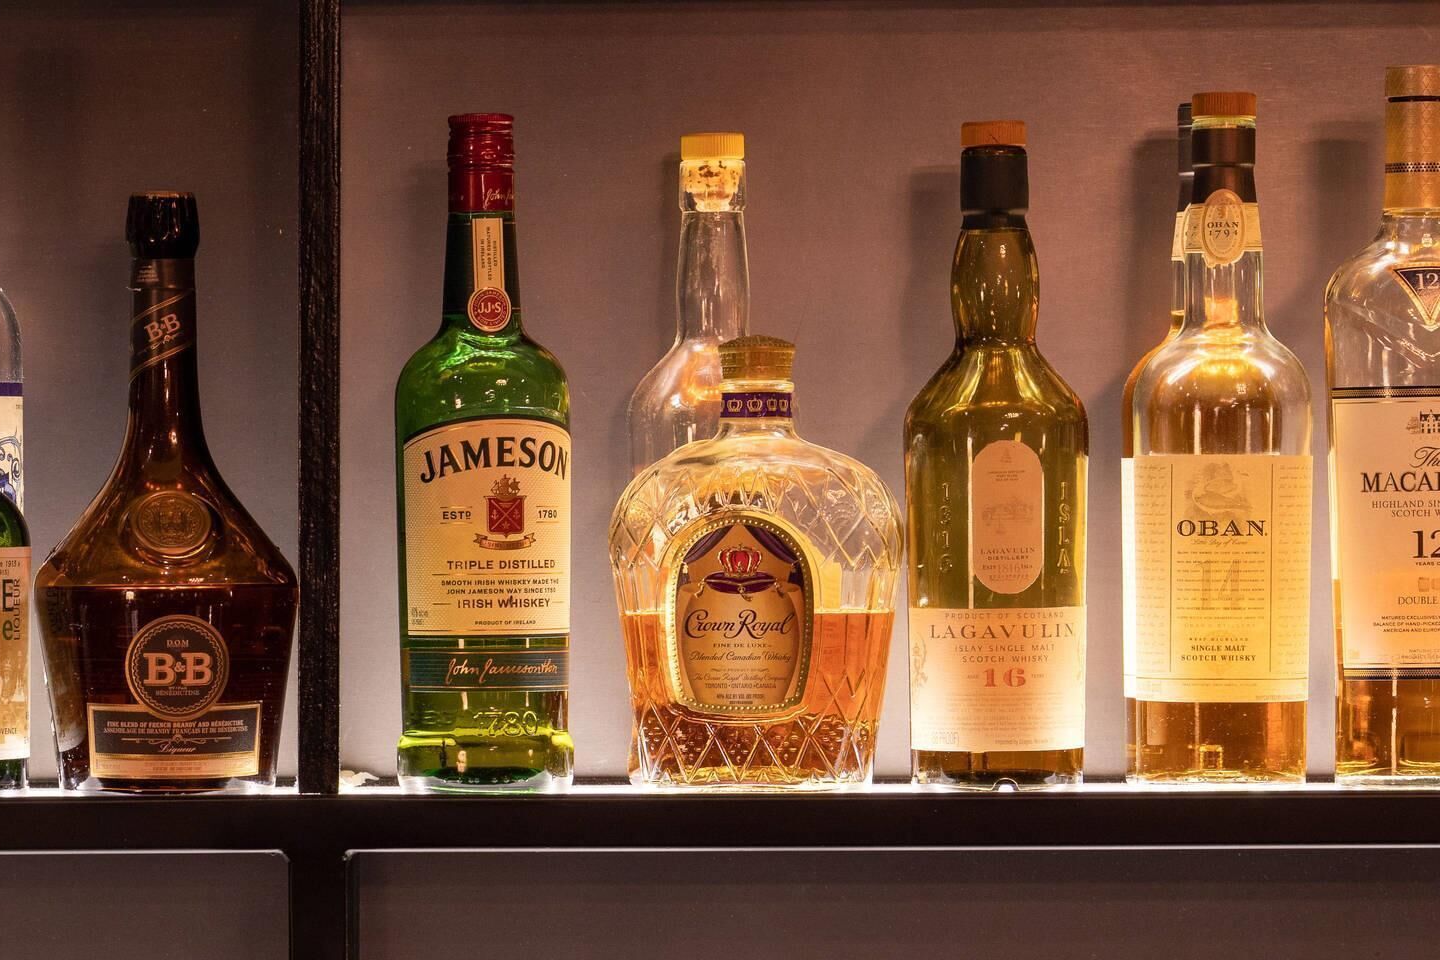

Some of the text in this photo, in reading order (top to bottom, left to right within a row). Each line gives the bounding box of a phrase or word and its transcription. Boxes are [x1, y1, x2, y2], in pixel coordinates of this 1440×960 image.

[1207, 221, 1239, 229] OBAN
[1208, 229, 1239, 238] 1794
[1416, 272, 1440, 291] 12
[145, 312, 182, 343] B&B
[420, 436, 569, 484] JAMESON
[1372, 499, 1425, 509] HIGHLAND
[537, 509, 558, 519] 1780
[1391, 508, 1431, 517] SCOTCH
[446, 559, 556, 570] TRIPLE DISTILLED
[457, 597, 551, 609] IRISH WHISKEY
[1397, 596, 1438, 606] DOUBLE
[13, 578, 21, 641] LIQUEUR
[945, 612, 993, 620] PRODUCT
[1016, 611, 1065, 619] SCOTLAND
[684, 608, 796, 640] Crown Royal
[930, 622, 1075, 640] LAGAVULIN
[955, 643, 1055, 653] ISLAY SINGLE MALT
[689, 650, 792, 664] Blended Canadian Whisky
[962, 654, 1049, 663] SCOTCH WHISKY
[1180, 654, 1257, 662] SCOTCH WHISKY
[143, 652, 214, 687] B&B
[983, 668, 1027, 688] 16
